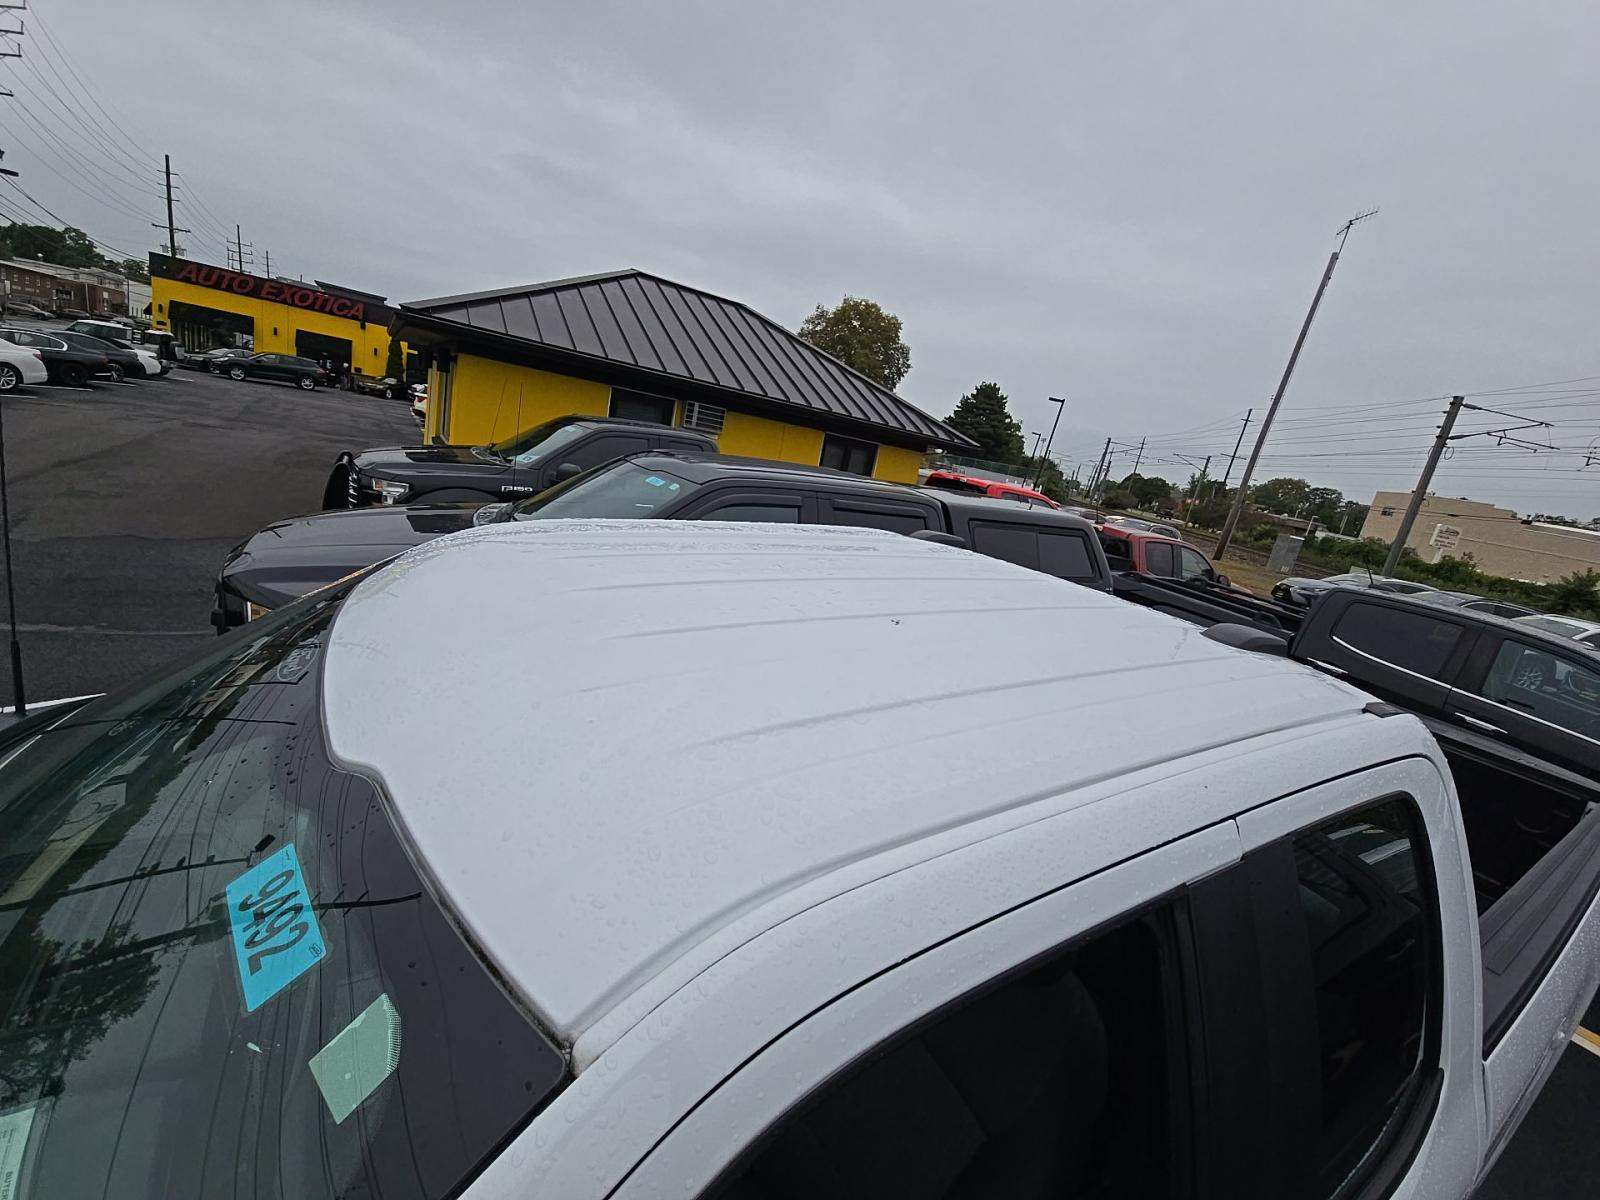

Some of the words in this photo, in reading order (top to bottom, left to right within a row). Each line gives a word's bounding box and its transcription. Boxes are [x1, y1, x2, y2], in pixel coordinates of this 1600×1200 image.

[176, 263, 254, 293] AUTO
[260, 282, 364, 319] EXOTICA
[238, 869, 309, 976] 9492
